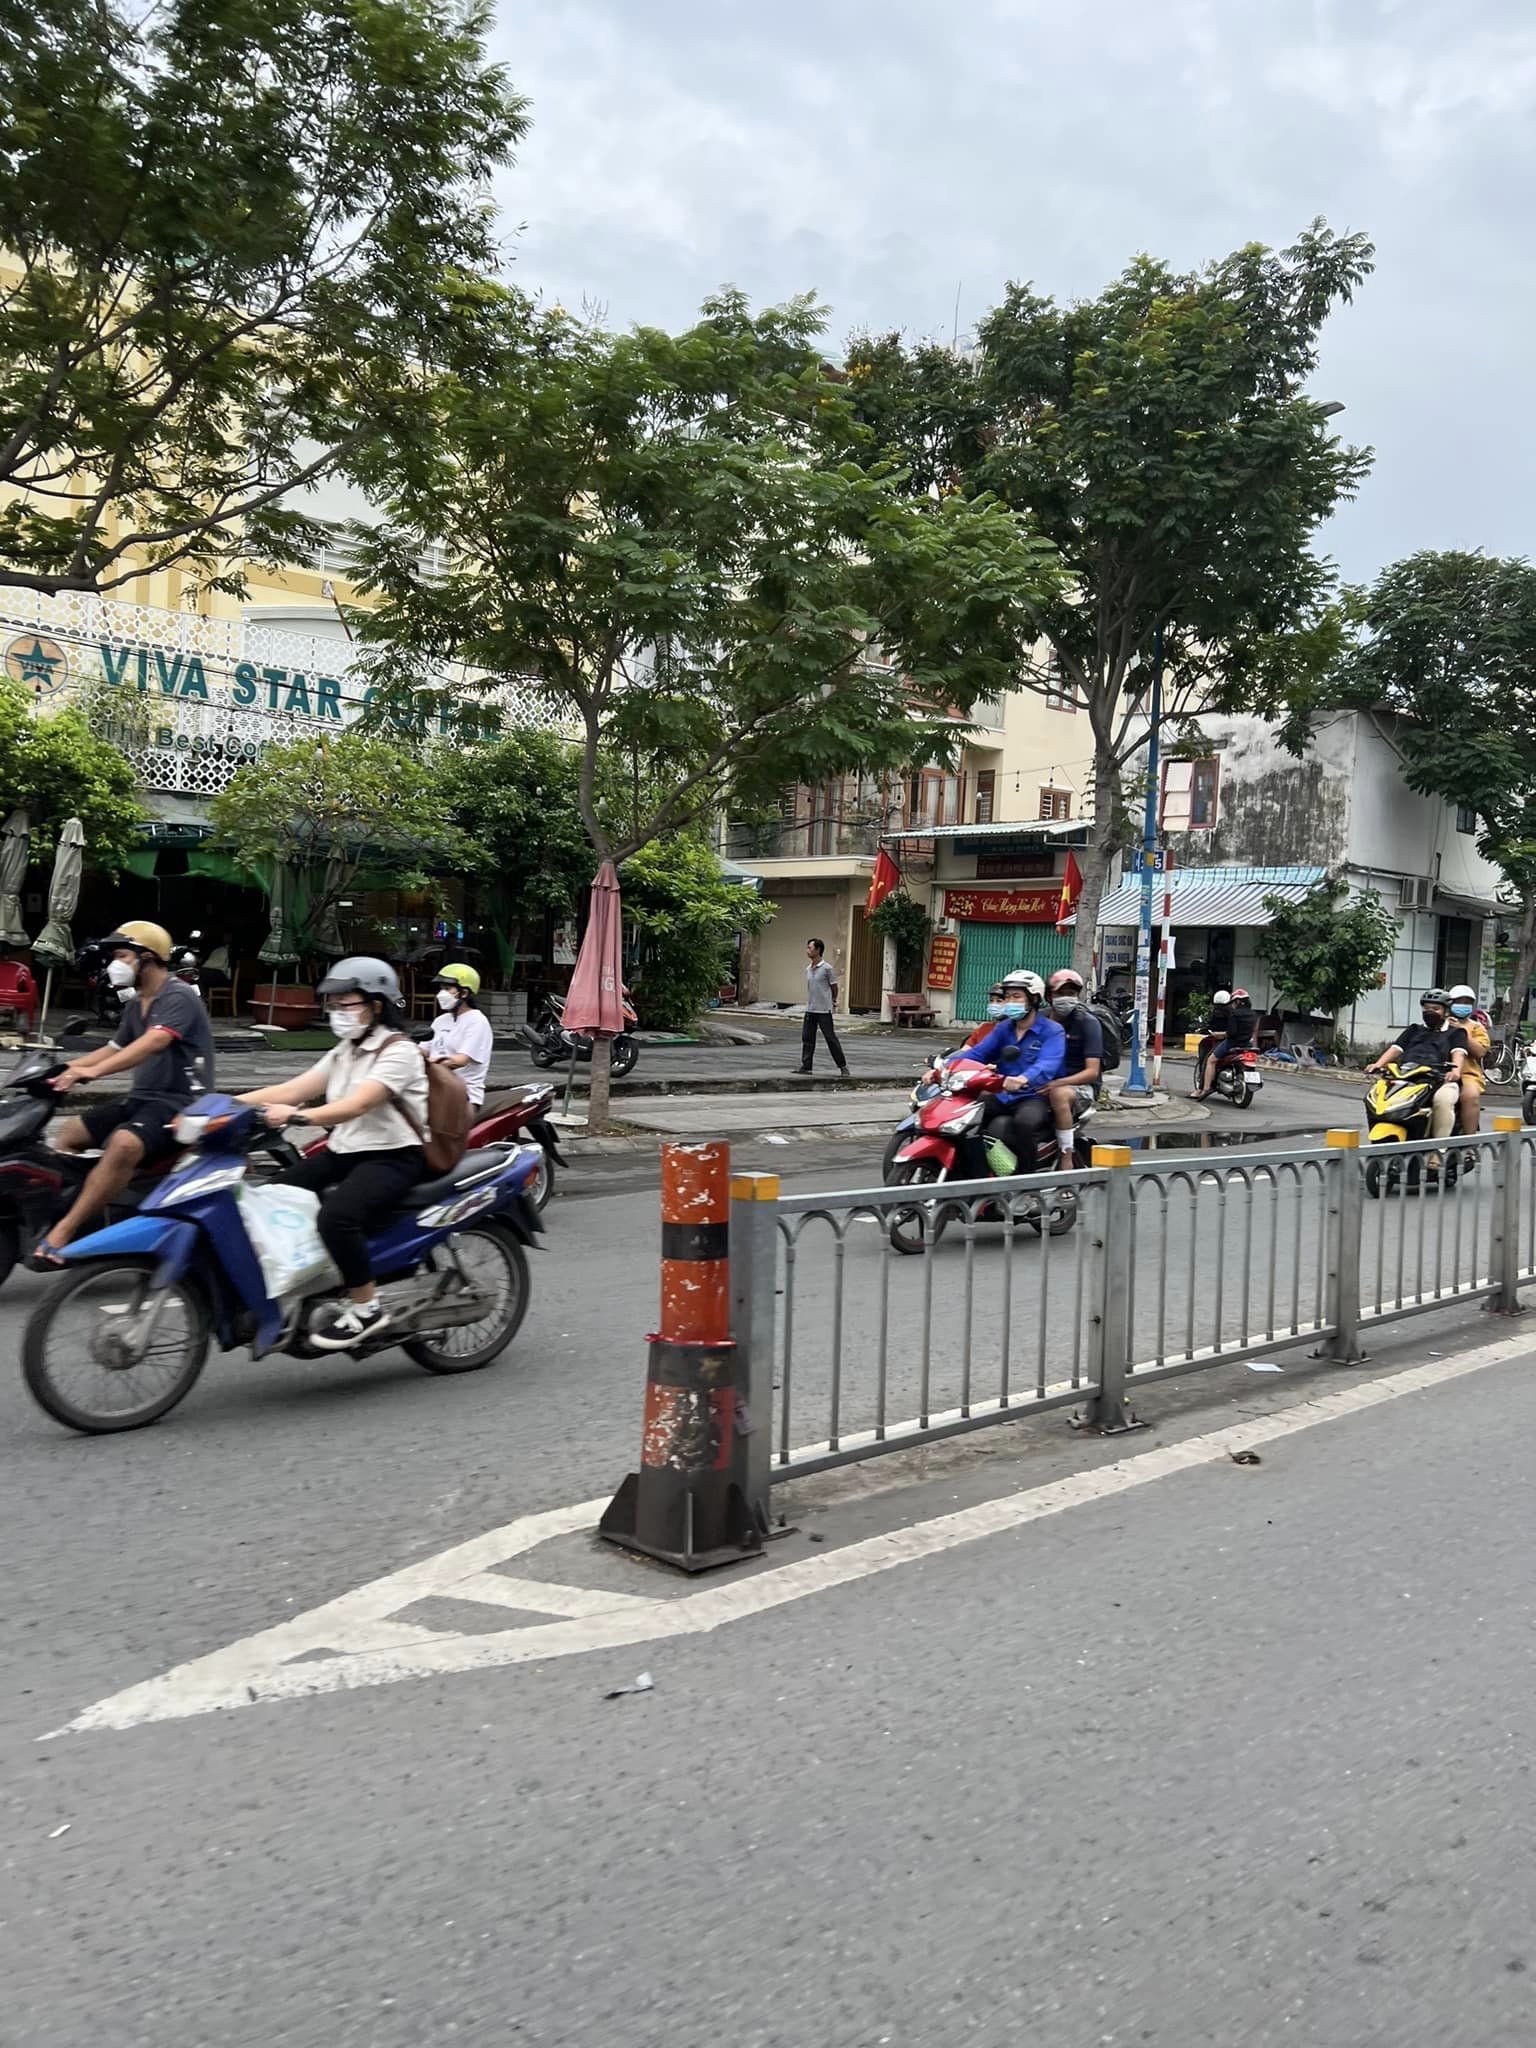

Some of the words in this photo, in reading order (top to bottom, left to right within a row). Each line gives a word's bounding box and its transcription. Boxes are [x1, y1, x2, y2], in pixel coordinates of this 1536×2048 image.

[100, 643, 209, 700] VIVA
[231, 661, 342, 720] STAR
[156, 726, 217, 752] Best
